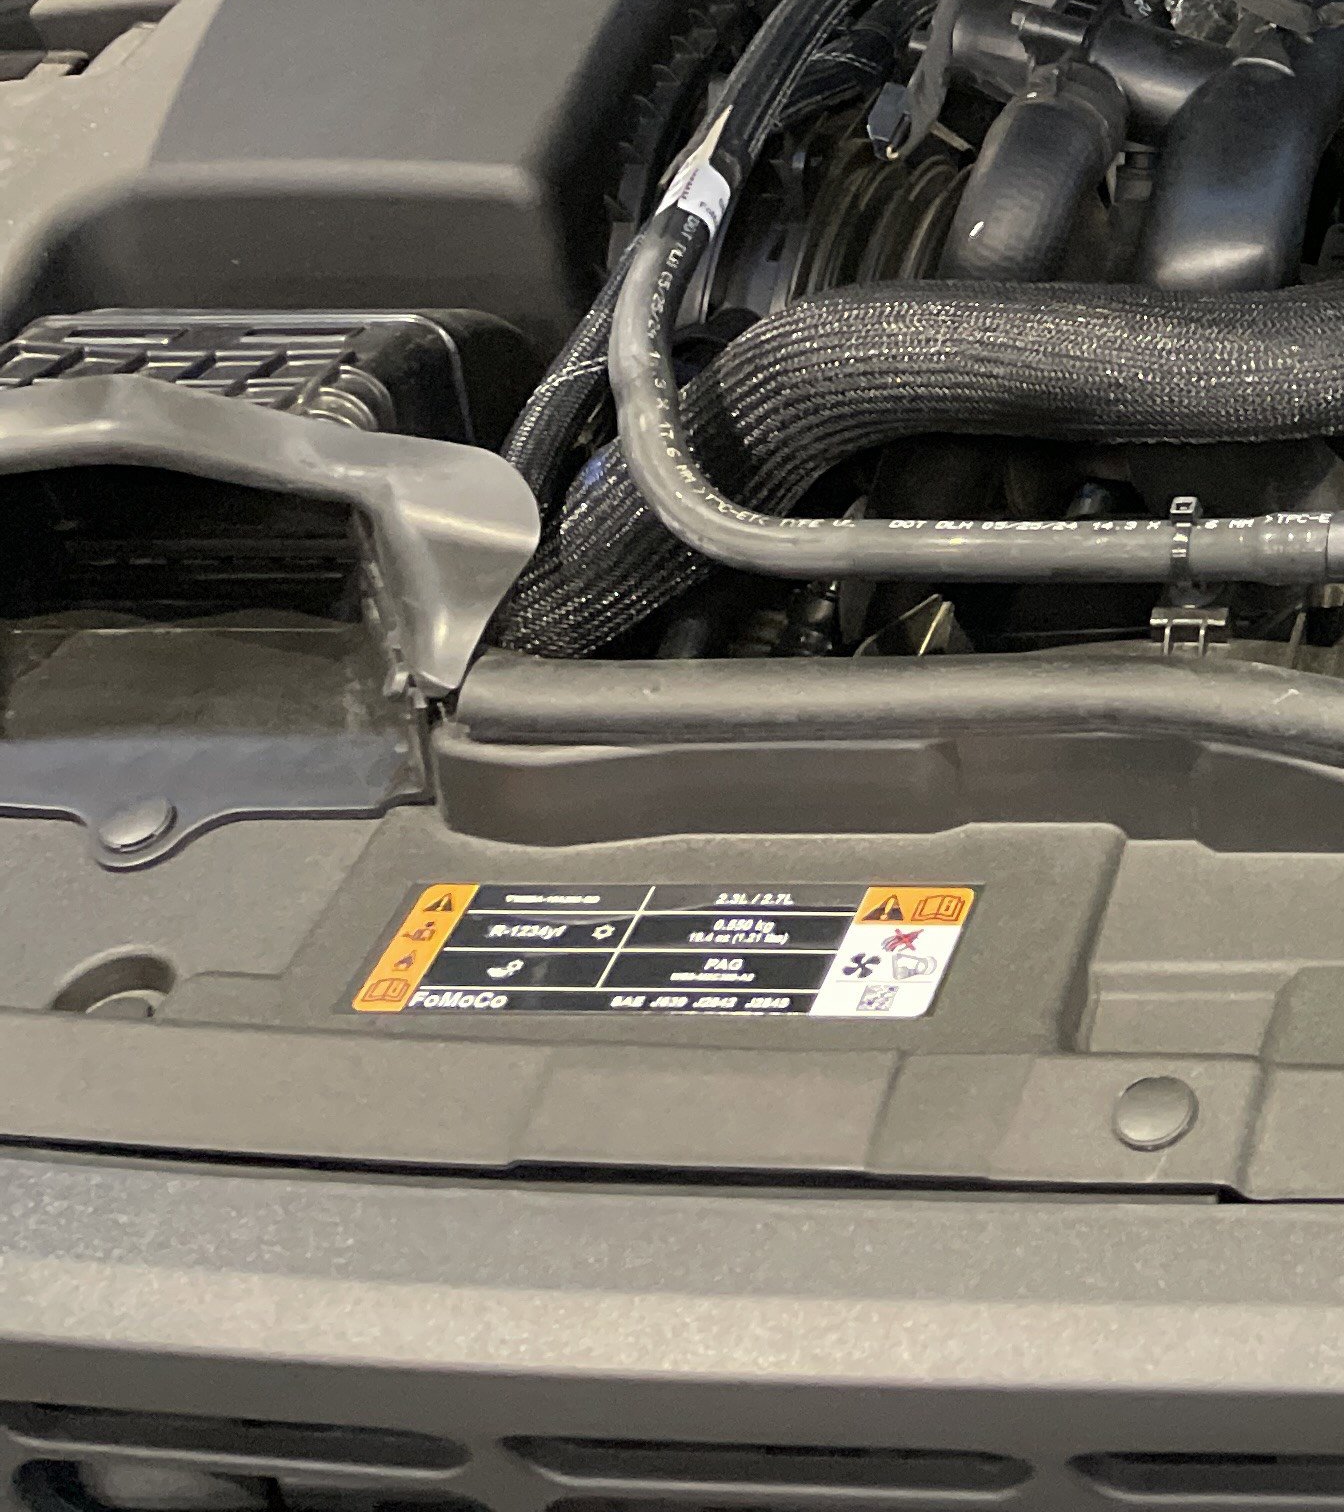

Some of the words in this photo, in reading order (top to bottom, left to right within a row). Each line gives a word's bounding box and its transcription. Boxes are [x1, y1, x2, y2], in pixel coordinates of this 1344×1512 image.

[487, 924, 568, 940] R-1234yf
[703, 958, 745, 971] PAG
[407, 991, 509, 1009] FoMoCo
